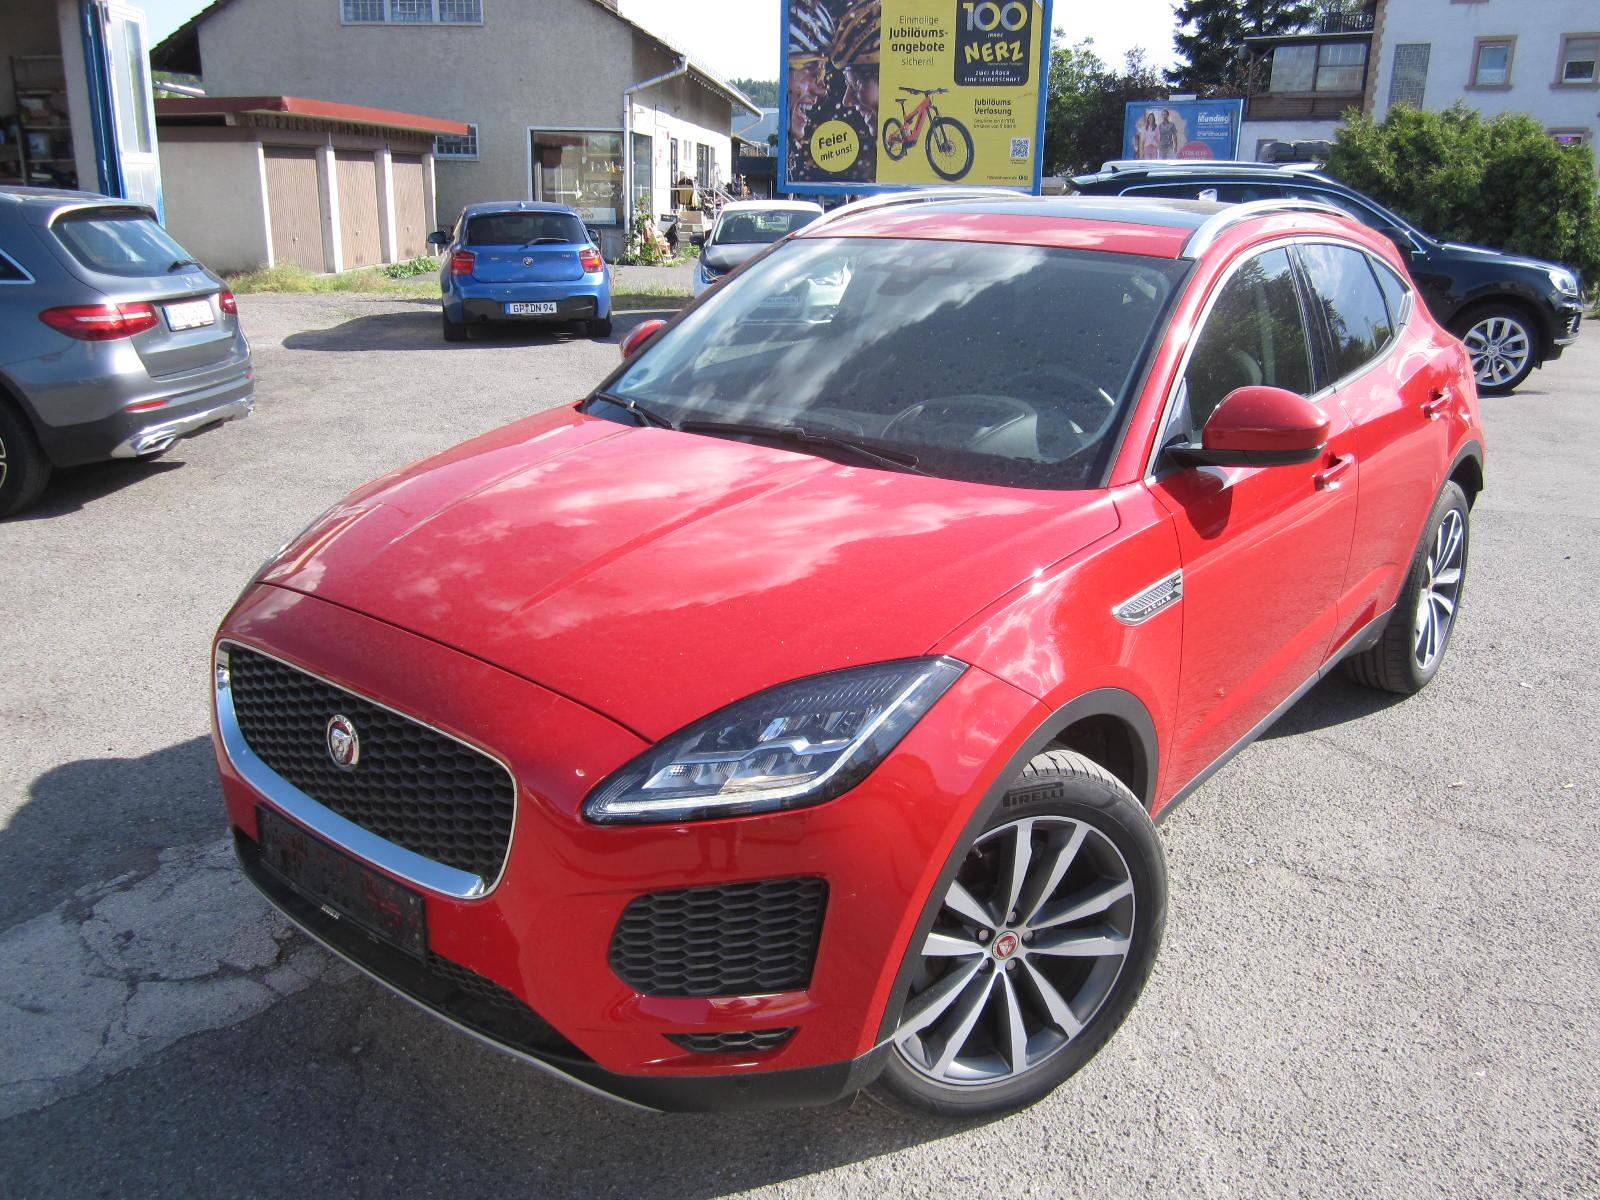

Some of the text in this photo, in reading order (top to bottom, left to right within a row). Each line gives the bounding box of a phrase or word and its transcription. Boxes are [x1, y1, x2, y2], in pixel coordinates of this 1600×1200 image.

[899, 16, 939, 25] Einmalige
[963, 2, 1028, 31] 100
[889, 27, 948, 40] Jubiläums-
[891, 41, 945, 54] angebote
[964, 41, 1024, 64] NERZ
[901, 57, 934, 66] sichern!
[974, 98, 1011, 106] Jubiläums
[974, 107, 1012, 116] Verlosung
[1197, 114, 1230, 124] Munding
[819, 132, 848, 149] Feier
[820, 144, 852, 161] mit uns!
[513, 303, 554, 313] GP DN 94
[1144, 596, 1171, 615] JAGUAR
[1002, 781, 1064, 808] PIRELLI
